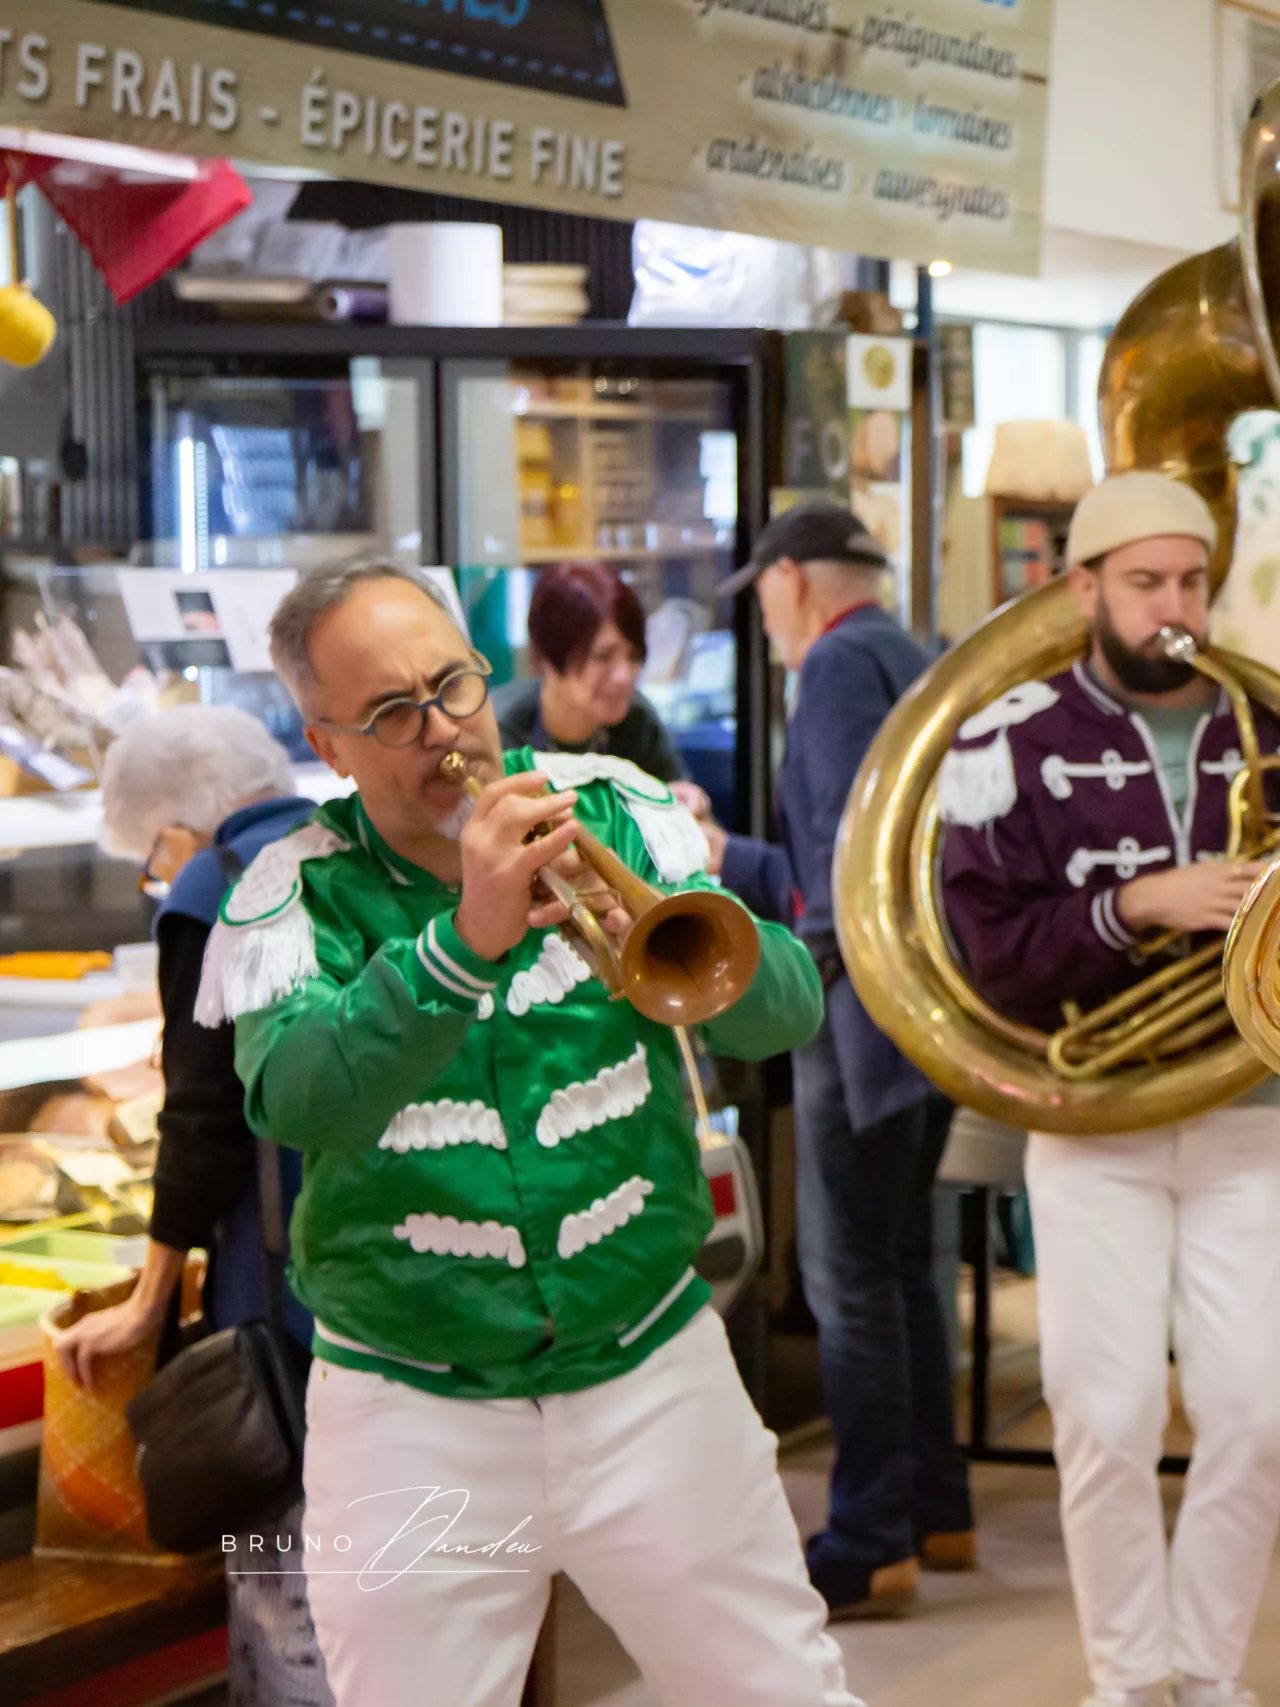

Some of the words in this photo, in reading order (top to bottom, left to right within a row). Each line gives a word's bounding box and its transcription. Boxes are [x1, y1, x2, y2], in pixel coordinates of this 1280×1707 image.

[75, 41, 237, 131] FRAIS
[301, 69, 515, 178] ÉPICERIE
[529, 127, 625, 197] FINE
